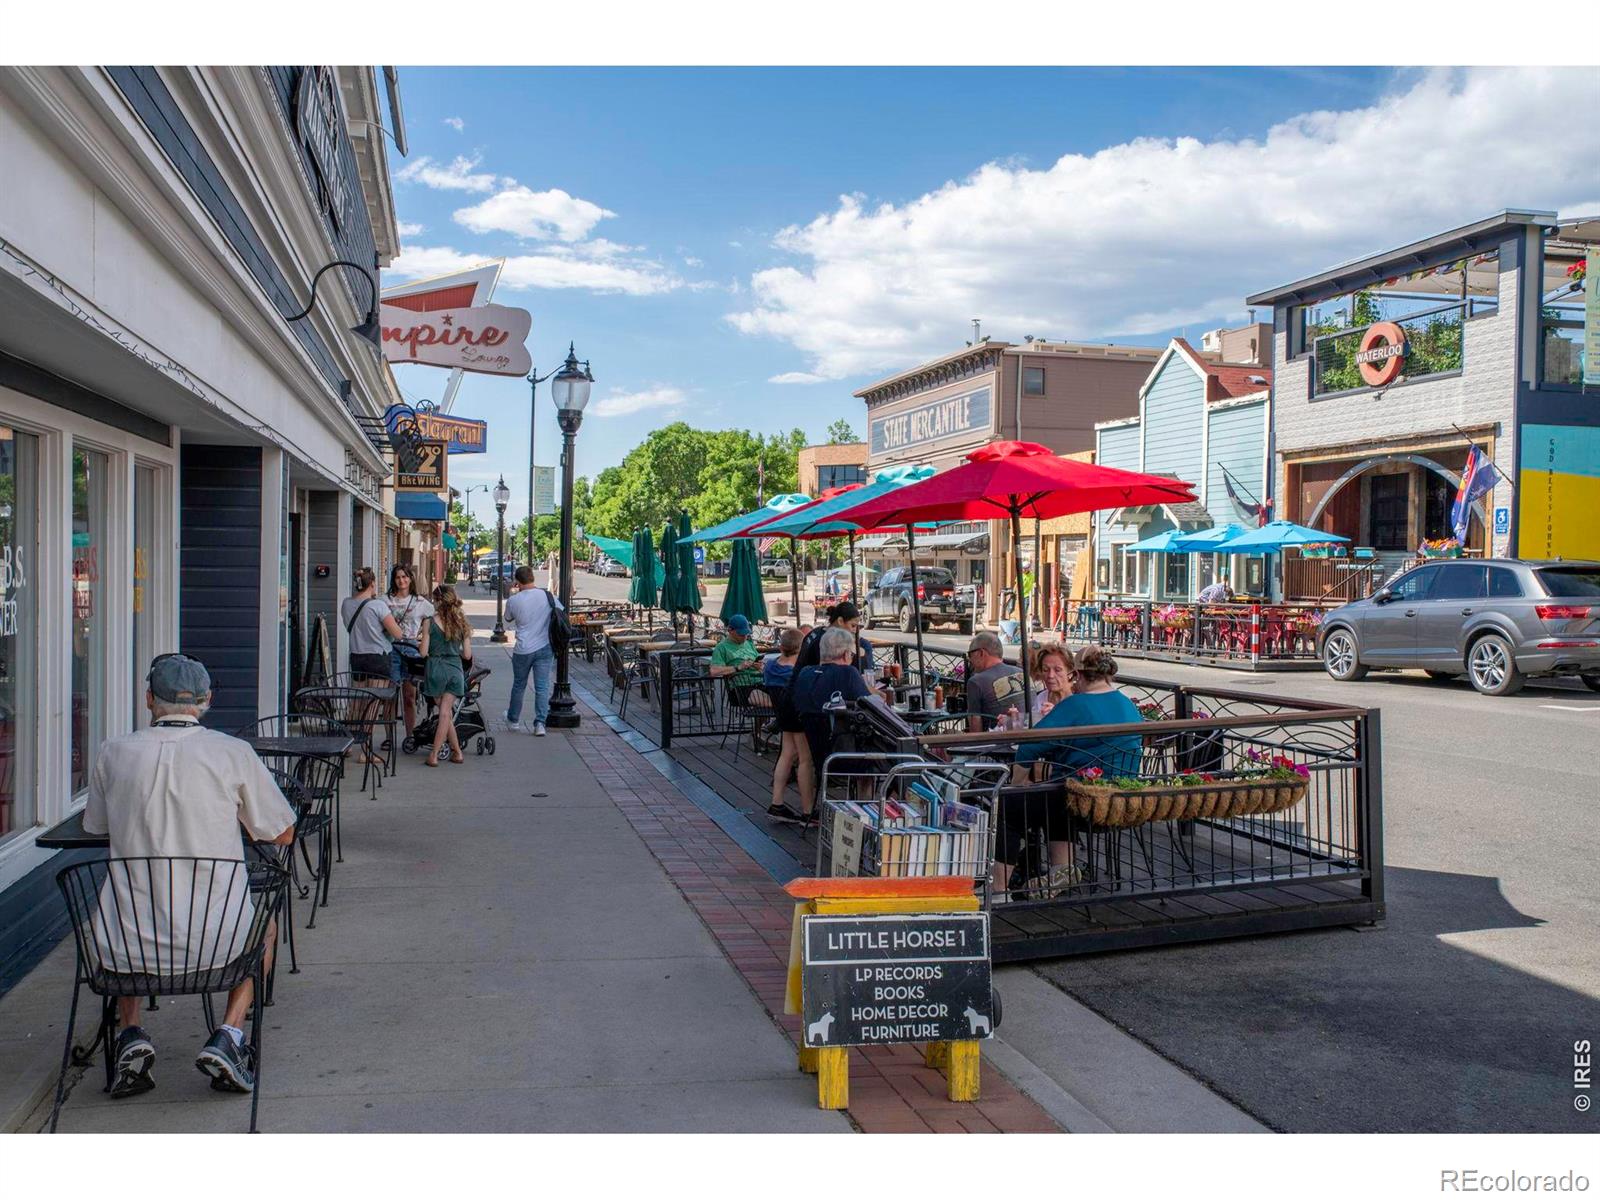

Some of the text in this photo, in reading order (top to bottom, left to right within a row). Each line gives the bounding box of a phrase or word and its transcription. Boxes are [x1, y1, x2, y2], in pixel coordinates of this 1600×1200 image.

[381, 315, 509, 358] mpire
[1355, 344, 1402, 364] WATERLOO
[883, 396, 971, 449] STATE MERCANTILE
[401, 475, 441, 487] BREWING
[828, 932, 889, 950] LITTLE
[894, 930, 956, 949] HORSE
[855, 966, 943, 982] LP RECORDS
[874, 986, 925, 1001] BOOKS
[851, 1004, 949, 1021] HOME DECOR
[861, 1023, 940, 1040] FURNITURE
